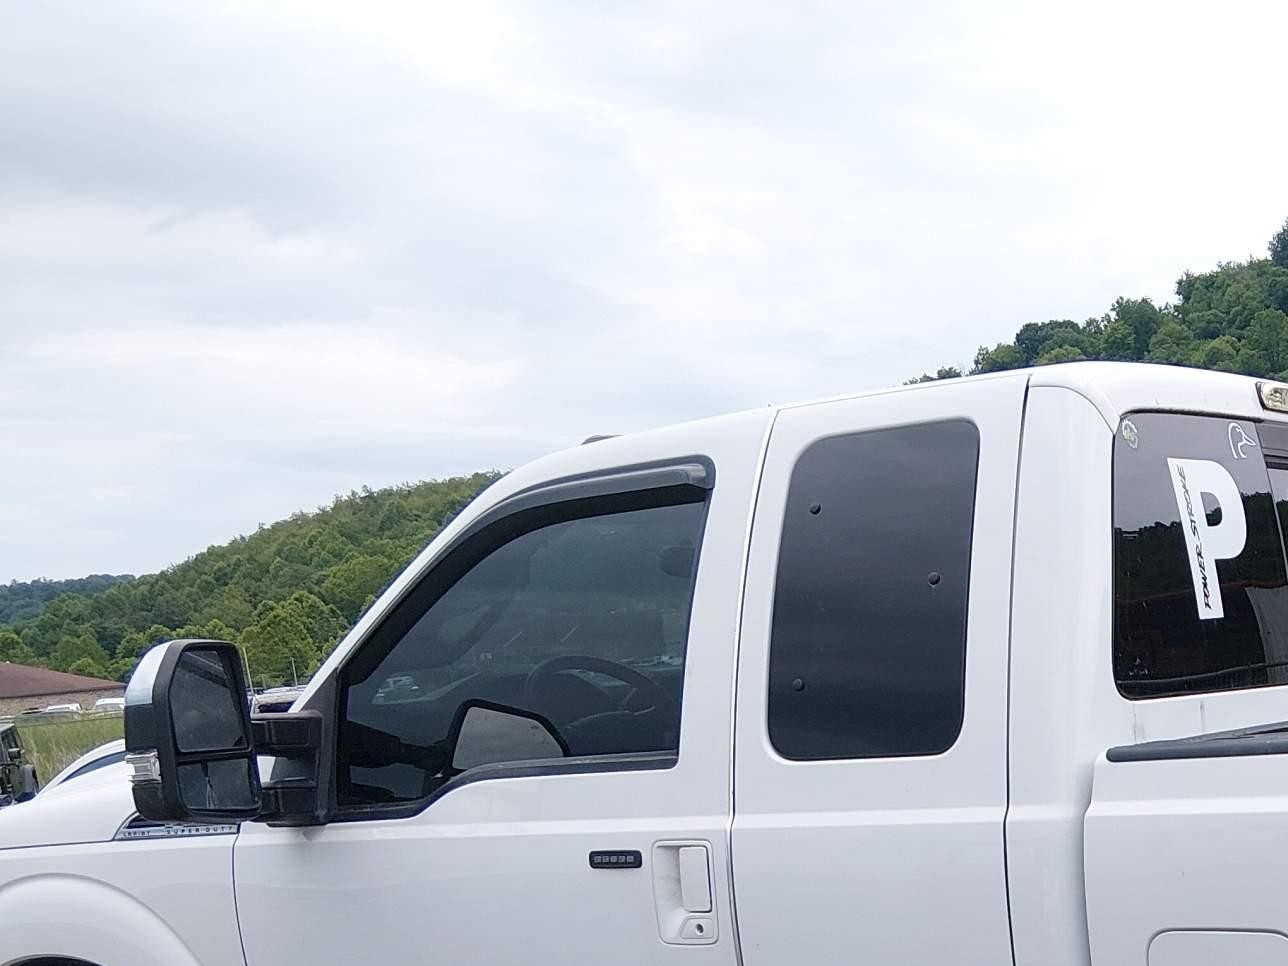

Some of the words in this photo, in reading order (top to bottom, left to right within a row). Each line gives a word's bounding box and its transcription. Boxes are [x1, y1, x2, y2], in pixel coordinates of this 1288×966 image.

[1176, 463, 1202, 541] STROKE
[1195, 541, 1213, 611] POWER
[205, 825, 233, 833] DUTY
